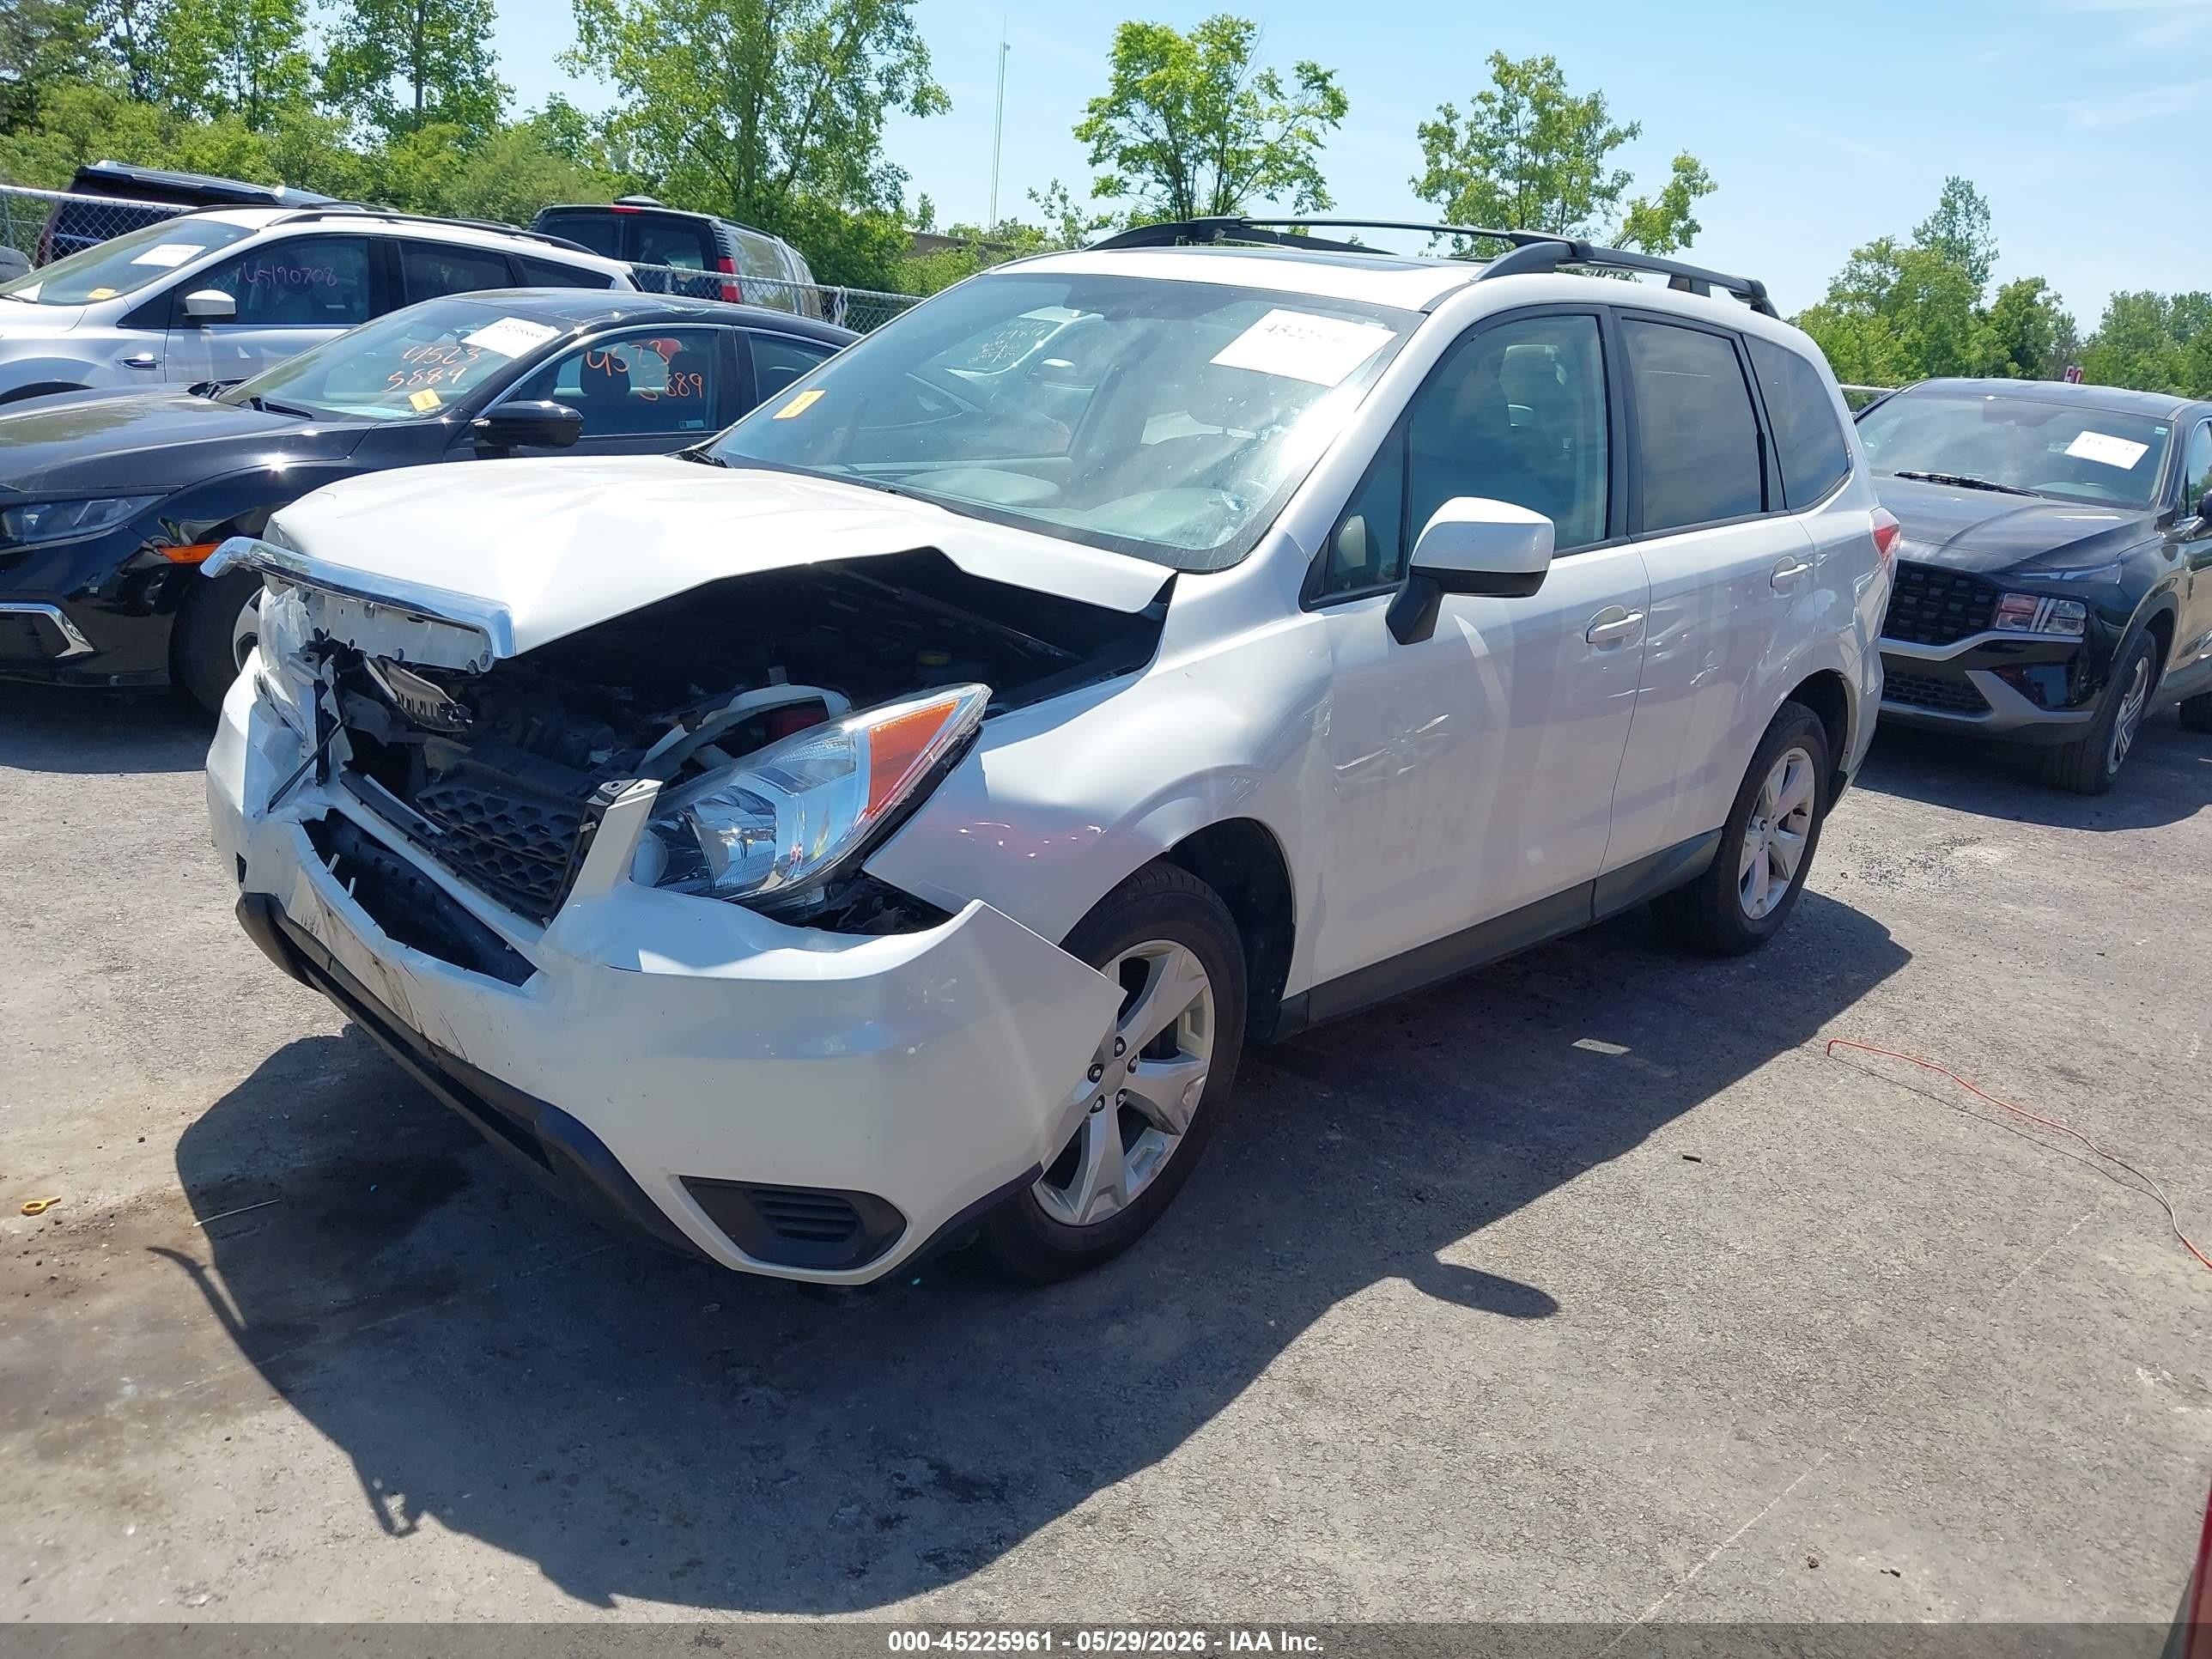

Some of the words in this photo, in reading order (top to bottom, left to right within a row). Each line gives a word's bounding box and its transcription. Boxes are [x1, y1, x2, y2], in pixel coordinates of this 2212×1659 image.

[243, 262, 337, 289] 45190708
[402, 345, 481, 365] 4523
[586, 339, 670, 377] 4523
